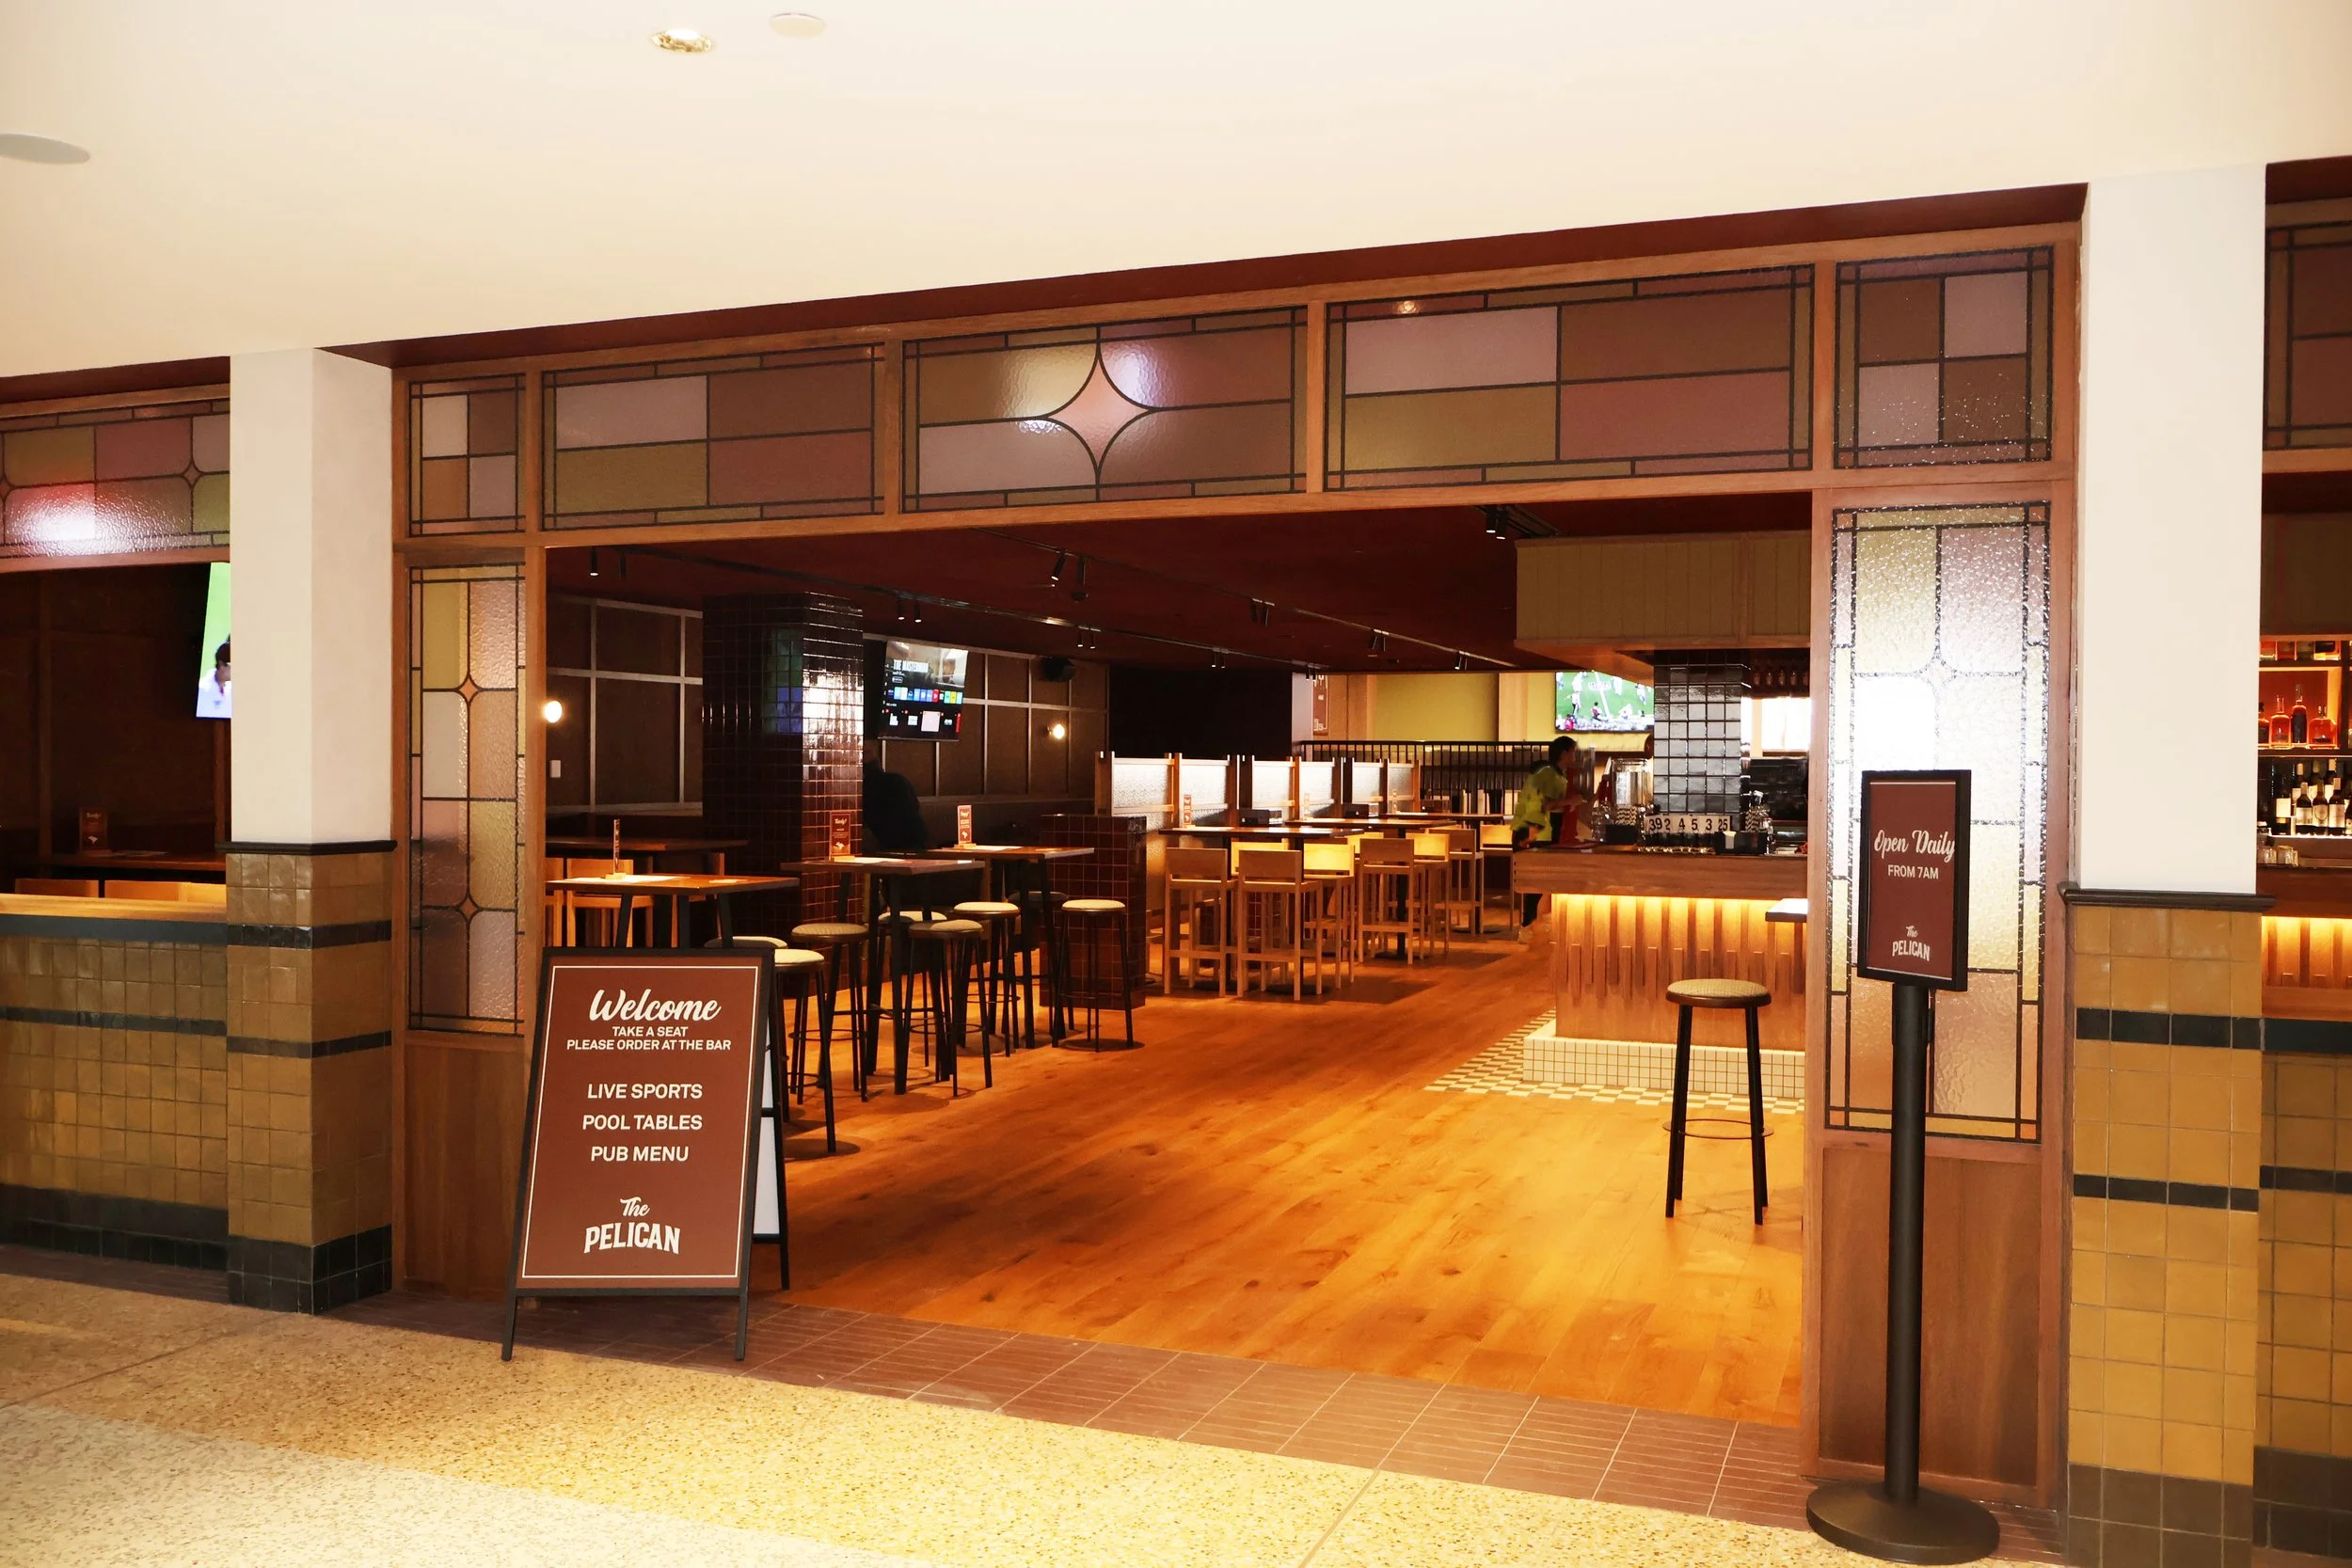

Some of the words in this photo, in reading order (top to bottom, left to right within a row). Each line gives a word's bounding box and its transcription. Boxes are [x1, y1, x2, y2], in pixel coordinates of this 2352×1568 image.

[1664, 818, 1671, 831] 2
[1678, 818, 1686, 830] 4
[1691, 818, 1698, 831] 5
[1706, 818, 1713, 831] 3
[1718, 818, 1728, 832] 25
[1874, 830, 1910, 860] Open
[1912, 830, 1955, 863] Daily
[1888, 864, 1915, 878] FROM
[1917, 866, 1939, 879] 7AM
[1906, 925, 1918, 938] The
[1892, 940, 1931, 962] PELICAN
[589, 989, 722, 1022] Welcome
[612, 1026, 644, 1037] TAKE
[645, 1026, 655, 1037] A
[657, 1026, 689, 1037] SEAT
[566, 1038, 614, 1051] PLEASE
[617, 1039, 660, 1051] ORDER
[661, 1039, 678, 1051] AT
[678, 1039, 704, 1051] THE
[706, 1039, 732, 1051] BAR
[587, 1084, 628, 1099] LIVE
[631, 1084, 704, 1100] SPORTS
[582, 1115, 630, 1130] POOL
[634, 1115, 703, 1130] TABLES
[591, 1147, 628, 1162] PUB
[633, 1147, 690, 1162] MENU
[620, 1196, 651, 1217] The
[583, 1222, 681, 1255] PELICAN
